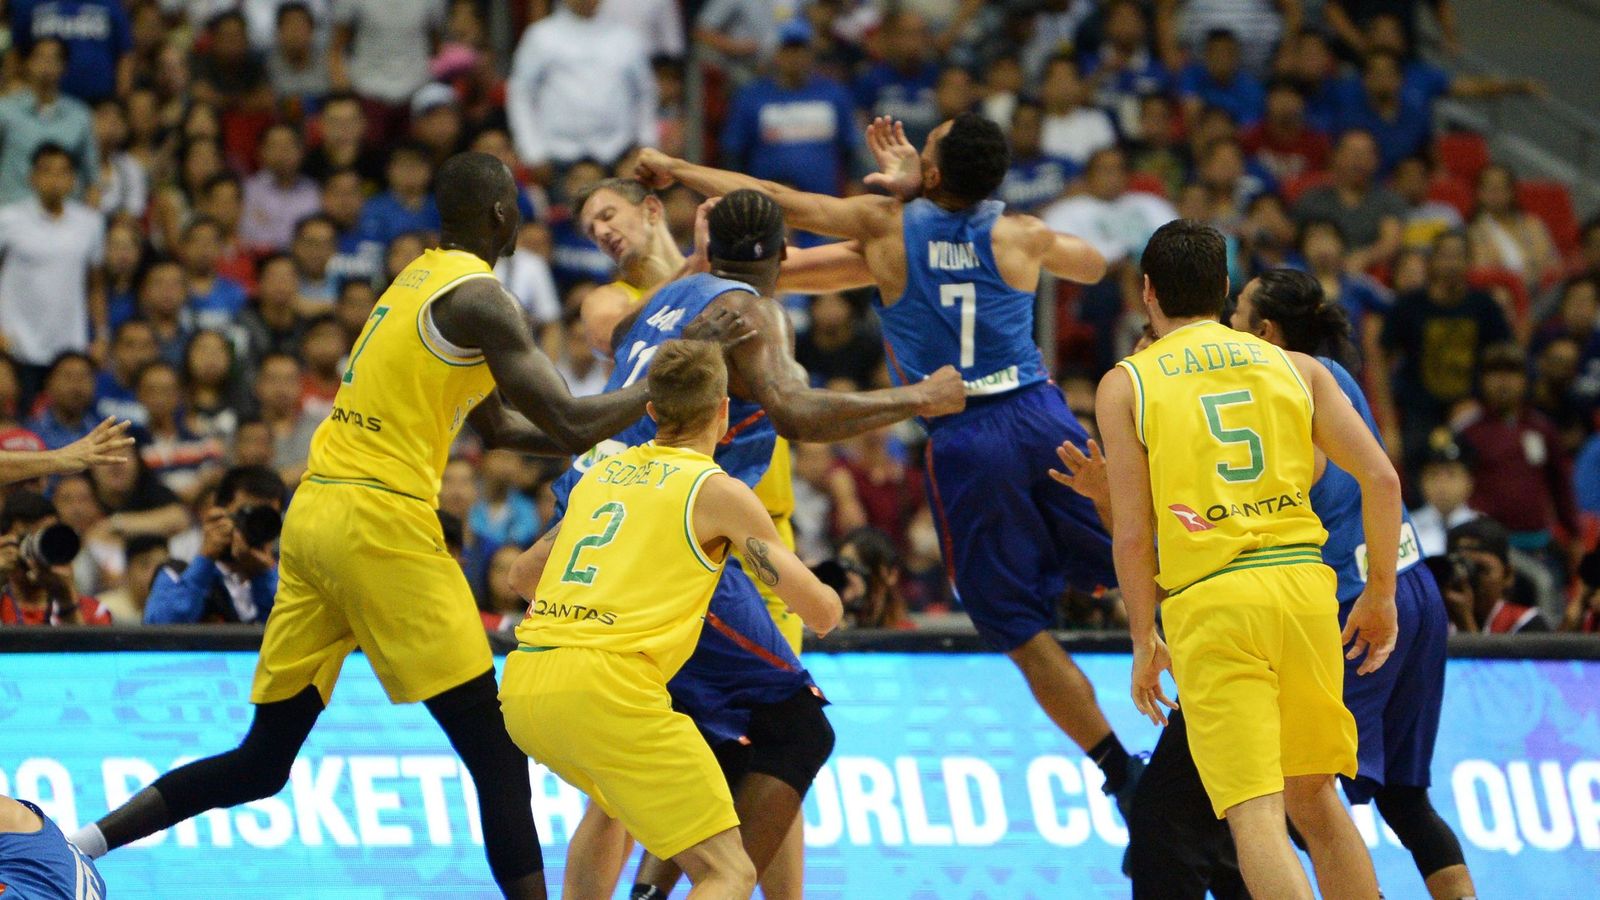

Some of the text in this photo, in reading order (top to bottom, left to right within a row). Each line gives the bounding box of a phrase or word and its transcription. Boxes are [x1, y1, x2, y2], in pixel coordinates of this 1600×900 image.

[342, 306, 390, 384] 7
[940, 282, 976, 368] 7
[1157, 342, 1269, 376] CADEE
[1200, 388, 1265, 484] 5
[561, 501, 627, 586] 2
[534, 599, 618, 626] QANTAS
[802, 756, 1009, 846] ORLD
